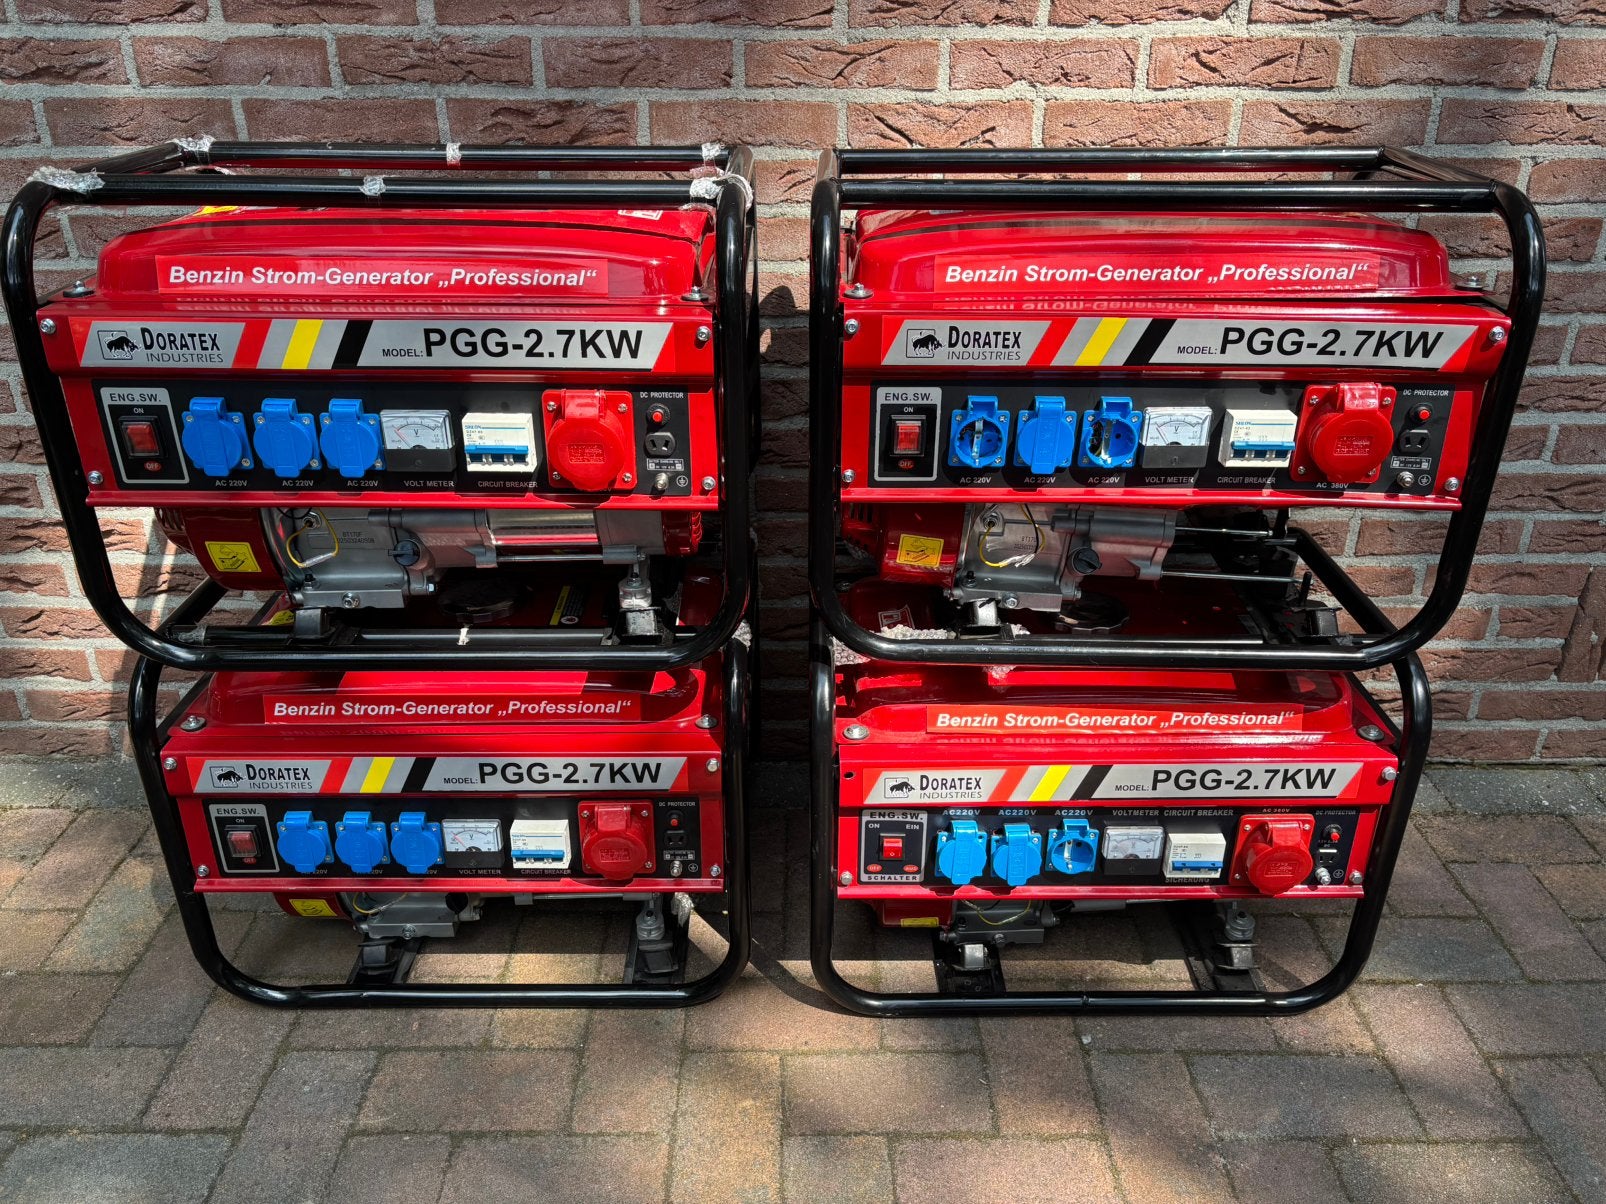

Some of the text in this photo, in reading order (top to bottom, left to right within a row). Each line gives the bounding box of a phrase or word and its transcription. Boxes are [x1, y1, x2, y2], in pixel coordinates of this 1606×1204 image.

[169, 266, 244, 284] Benzin
[250, 266, 434, 286] Strom-Generator
[945, 266, 1018, 282] Benzin
[1024, 264, 1203, 283] Strom-Generator
[140, 327, 221, 352] DORATEX
[382, 327, 643, 360] MODEL: PGG-2.7KW
[947, 325, 1022, 349] DORATEX
[1176, 326, 1444, 359] MODEL: PGG-2.7KW
[146, 351, 224, 364] INDUSTRIES
[947, 350, 1022, 361] INDUSTRIES
[110, 392, 162, 402] ENG.SW.
[884, 392, 933, 402] ENG.SW.
[146, 462, 160, 470] OFF
[274, 702, 336, 716] Benzin
[341, 702, 493, 716] Strom-Generator
[936, 713, 998, 727] Benzin
[1004, 712, 1156, 727] Strom-Generator
[246, 764, 310, 781] DORATEX
[478, 762, 662, 784] PGG-2.7KW
[1114, 768, 1336, 792] MODEL: PGG-2.7KW
[249, 780, 313, 790] INDUSTRIES
[919, 774, 982, 791] DORATEX
[919, 791, 982, 800] INDUSTRIES
[870, 811, 923, 820] ENG.SW.
